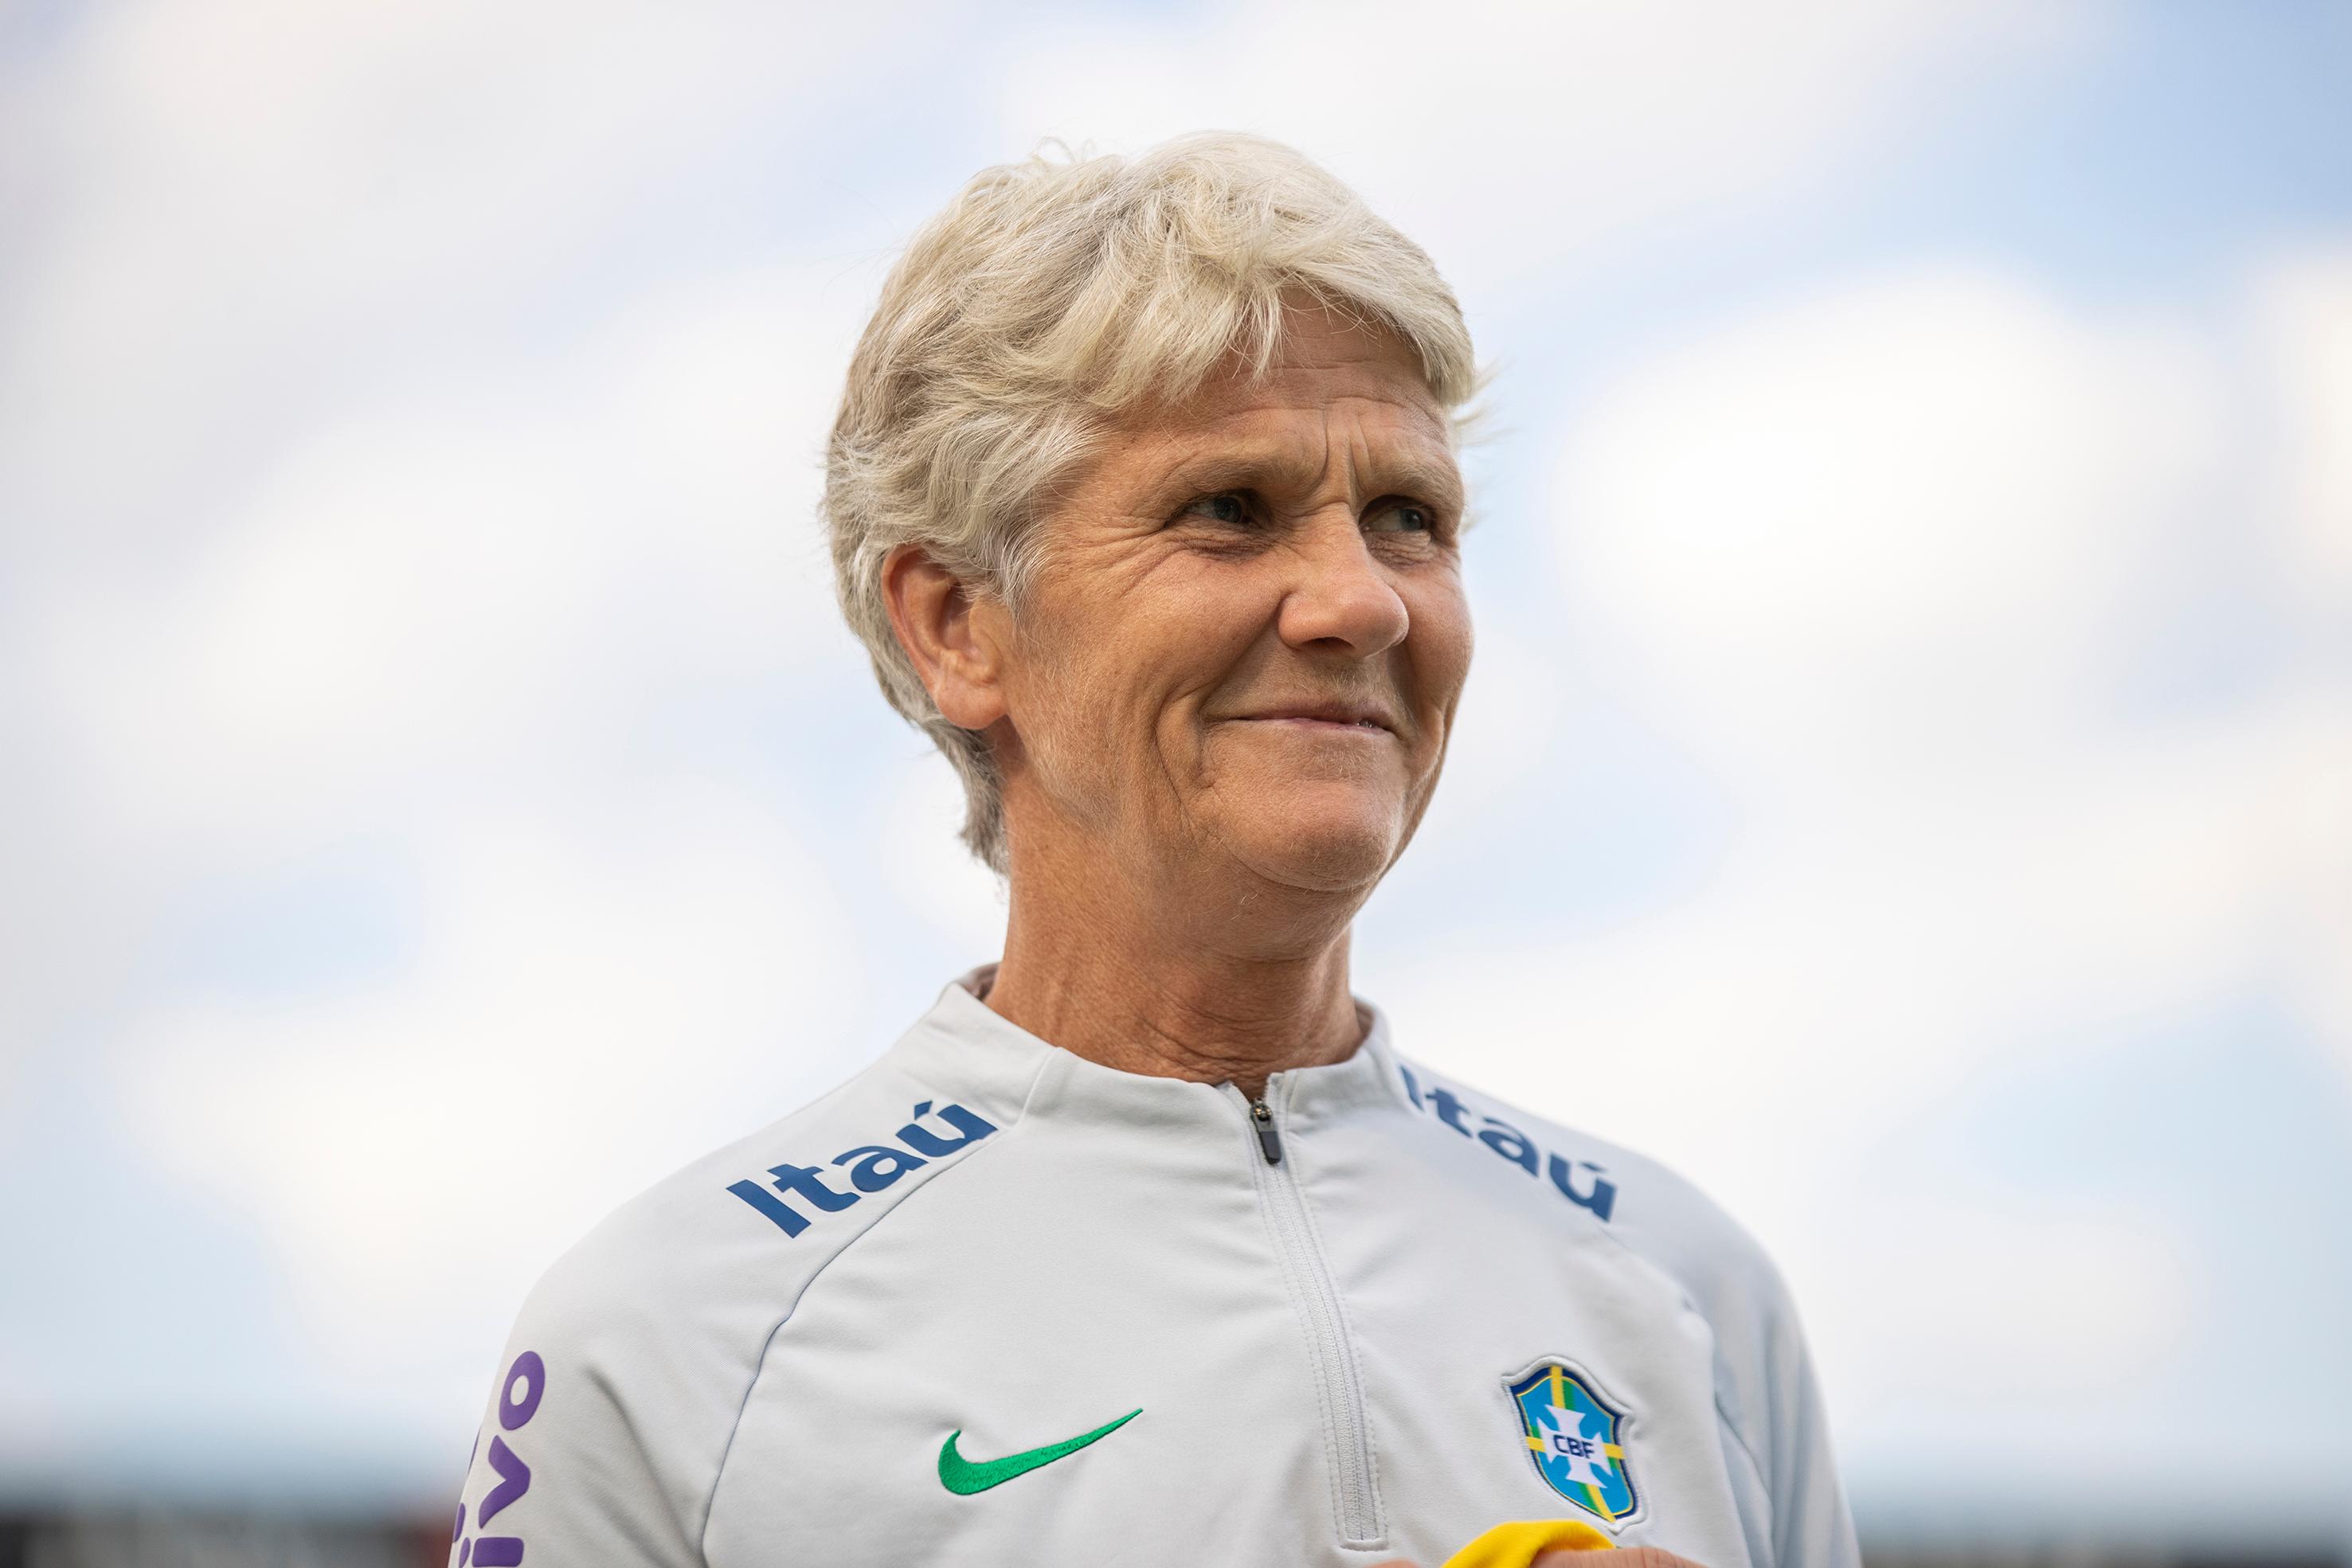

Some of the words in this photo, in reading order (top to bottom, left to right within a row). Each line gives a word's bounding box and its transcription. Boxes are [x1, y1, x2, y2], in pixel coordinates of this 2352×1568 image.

[726, 1100, 999, 1239] Itaú
[1399, 1064, 1618, 1224] Itaú
[1552, 1434, 1595, 1460] CBF
